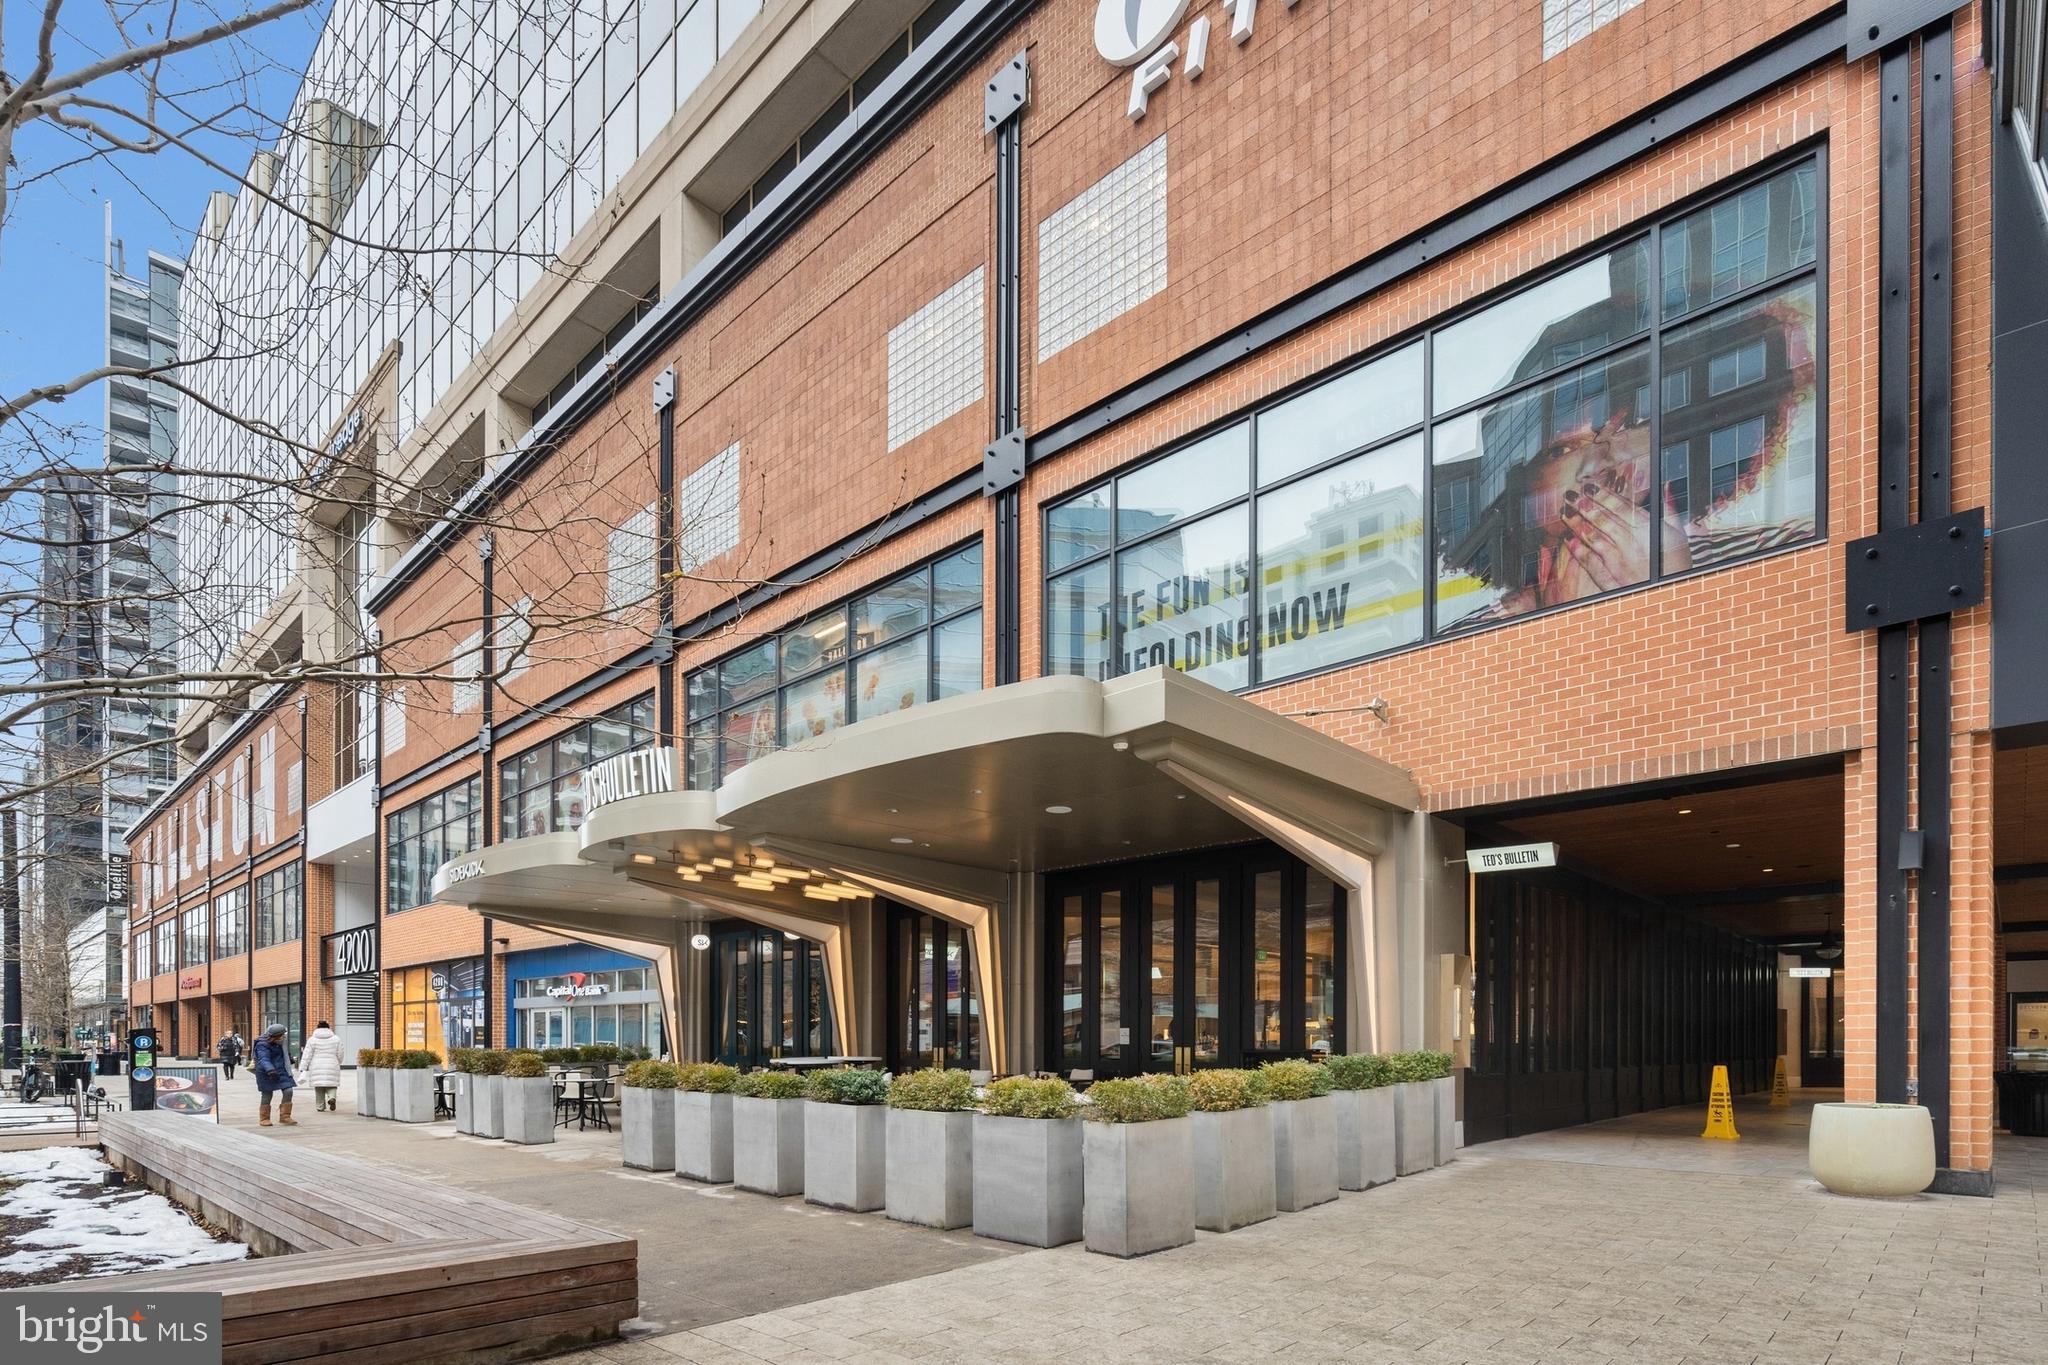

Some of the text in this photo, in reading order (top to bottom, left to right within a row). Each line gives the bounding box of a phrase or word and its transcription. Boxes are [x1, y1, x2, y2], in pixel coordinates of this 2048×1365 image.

[1157, 574, 1210, 622] FUN
[1268, 582, 1350, 649] NOW
[598, 745, 673, 806] BULLETIN
[141, 726, 276, 915] BALLSTON
[1482, 850, 1539, 867] TED'S BULLETIN
[337, 929, 370, 975] 4200
